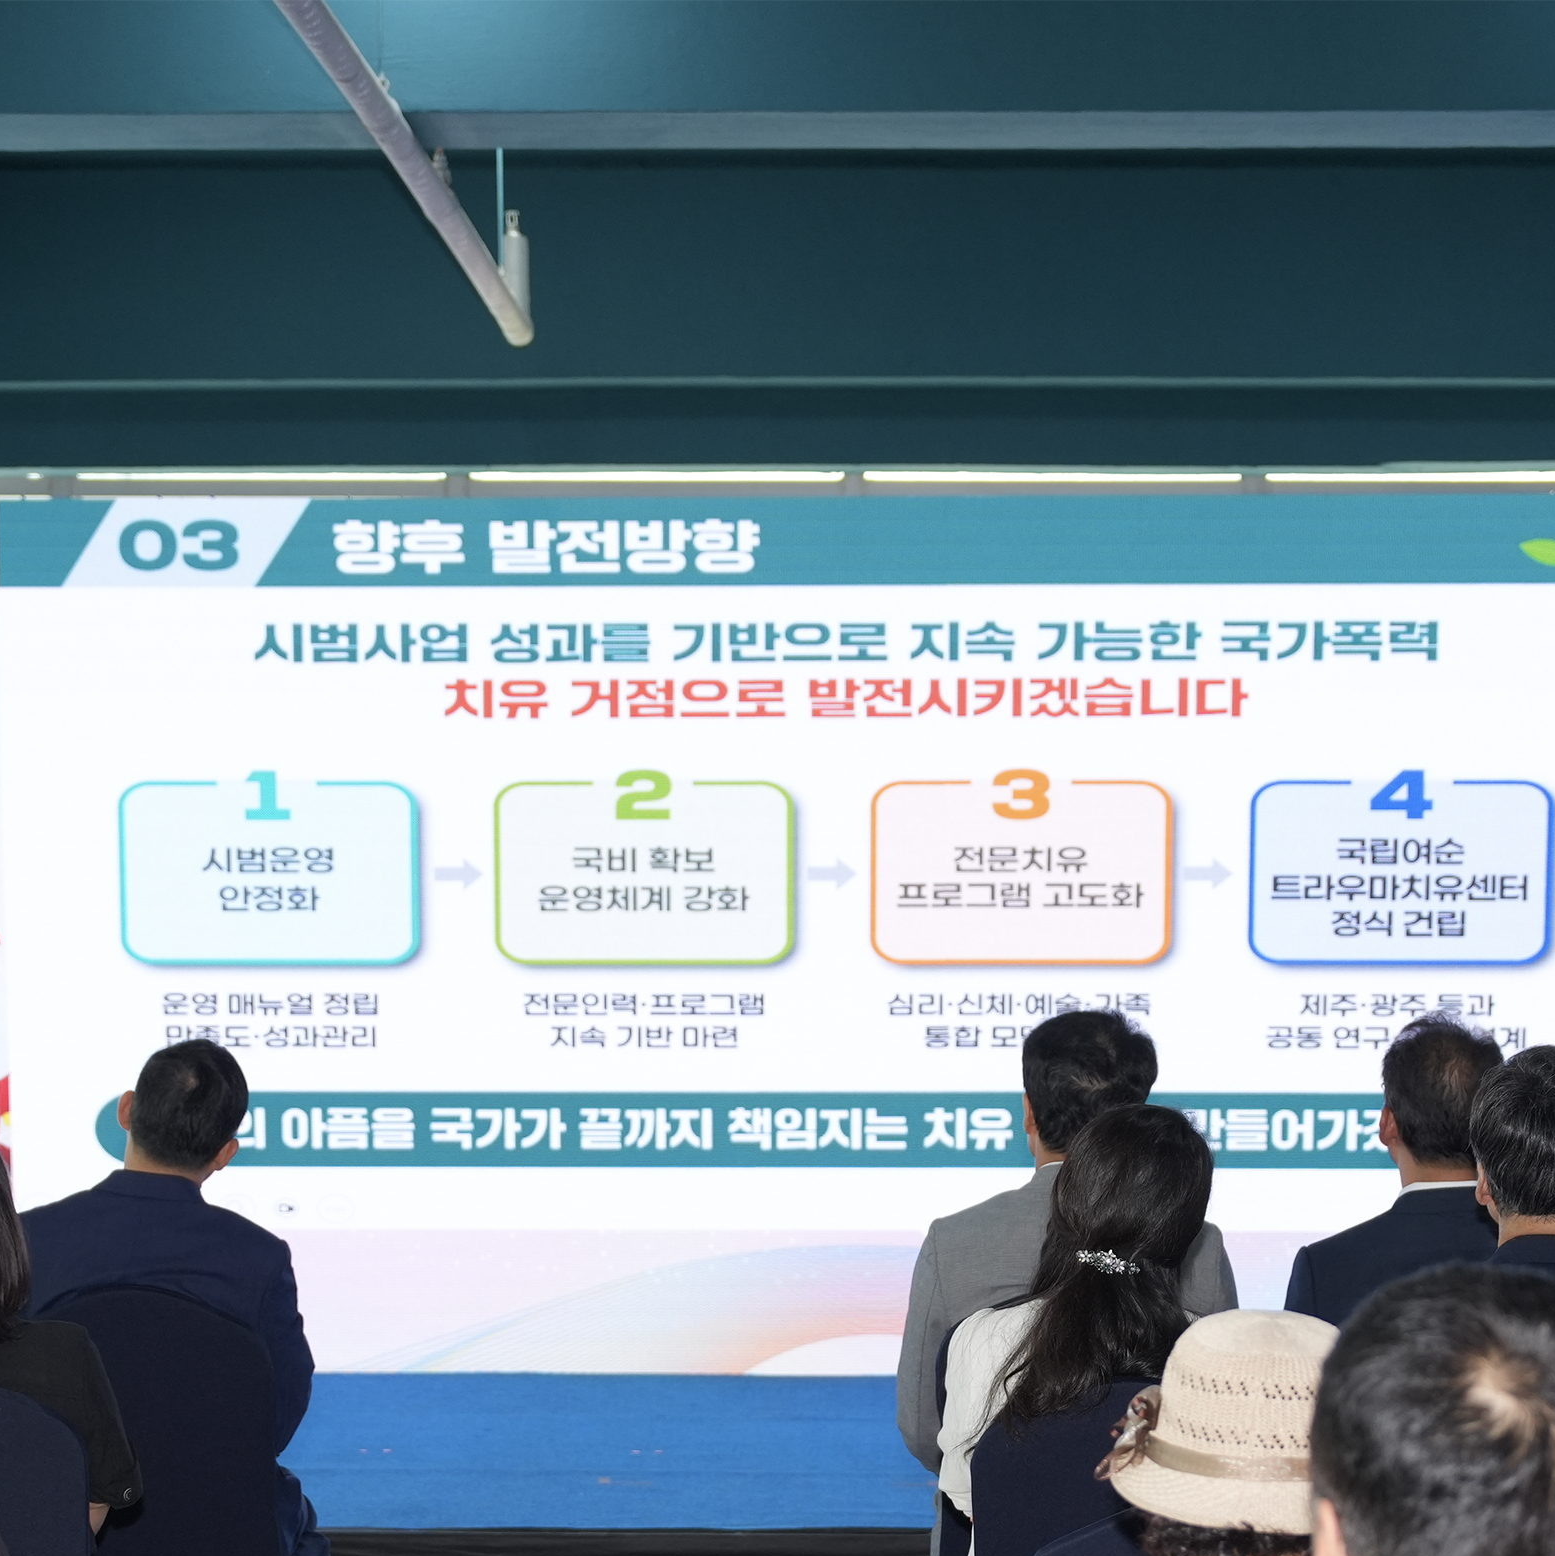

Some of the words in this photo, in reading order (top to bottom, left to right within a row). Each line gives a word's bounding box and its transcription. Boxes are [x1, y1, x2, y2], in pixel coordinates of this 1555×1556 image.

[118, 519, 239, 572] 03
[332, 519, 465, 575] 향후
[489, 518, 760, 574] 발전방향
[255, 623, 468, 663] 시범사업
[491, 623, 650, 663] 성과를
[674, 622, 888, 663] 기반으로
[910, 621, 1015, 662] 지속
[1038, 620, 1202, 661] 가능한
[1221, 621, 1439, 661] 국가폭력
[445, 679, 548, 719] 치유
[572, 679, 785, 718] 거점으로
[809, 677, 1248, 717] 발전시키겠습니다
[245, 770, 291, 821] 1
[616, 770, 672, 820] 2
[993, 769, 1050, 820] 3
[1370, 770, 1433, 819] 4
[202, 847, 334, 874] 시범운영
[573, 847, 636, 873] 국비
[649, 846, 714, 873] 확보
[955, 847, 1087, 873] 전문치유
[1337, 838, 1464, 865] 국립여순
[219, 886, 319, 912] 안정화
[539, 886, 671, 912] 운영체계
[685, 886, 749, 912] 강화
[898, 883, 1030, 908] 프로그램
[1043, 882, 1144, 908] 고도화
[1271, 875, 1528, 902] 트라우마치유센터
[1332, 911, 1393, 937] 정식
[1404, 911, 1466, 937] 건립
[163, 993, 217, 1016] 운영
[229, 993, 312, 1016] 매뉴얼
[325, 993, 378, 1016] 정립
[551, 1026, 606, 1048] 지속
[618, 1026, 673, 1048] 기반
[683, 1026, 737, 1048] 마련
[925, 1026, 981, 1048] 통합
[1267, 1026, 1322, 1049] 공동
[1334, 1026, 1389, 1049] 연구
[281, 1107, 415, 1150] 아픔을
[430, 1108, 567, 1150] 국가가
[579, 1108, 713, 1150] 끝까지
[728, 1107, 908, 1151] 책임지는
[923, 1107, 1013, 1150] 치유
